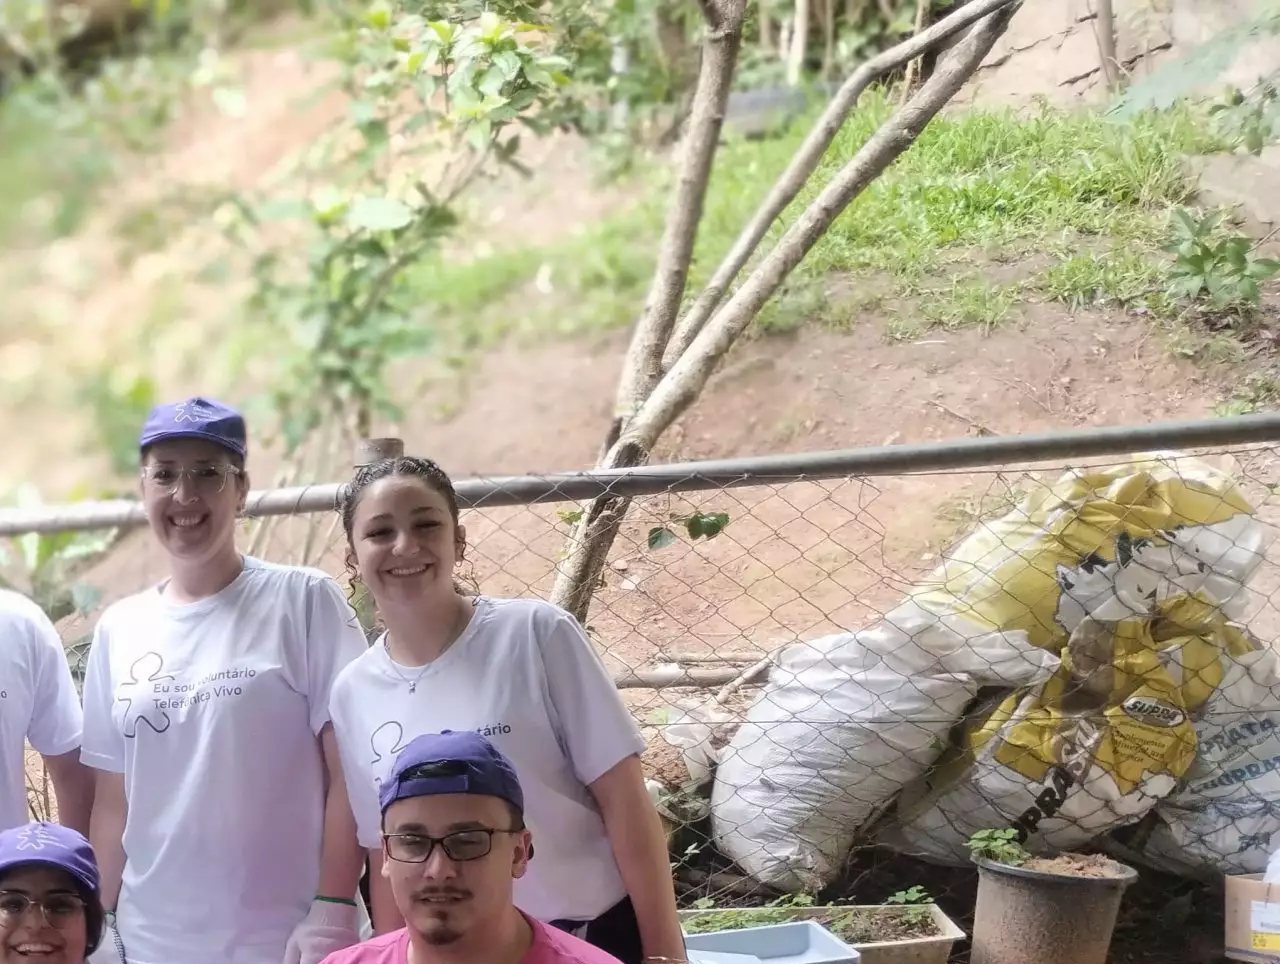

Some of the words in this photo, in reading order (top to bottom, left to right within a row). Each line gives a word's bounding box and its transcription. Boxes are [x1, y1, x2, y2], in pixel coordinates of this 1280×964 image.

[153, 683, 170, 693] Eu
[174, 683, 195, 693] sou
[213, 685, 242, 698] Vivo
